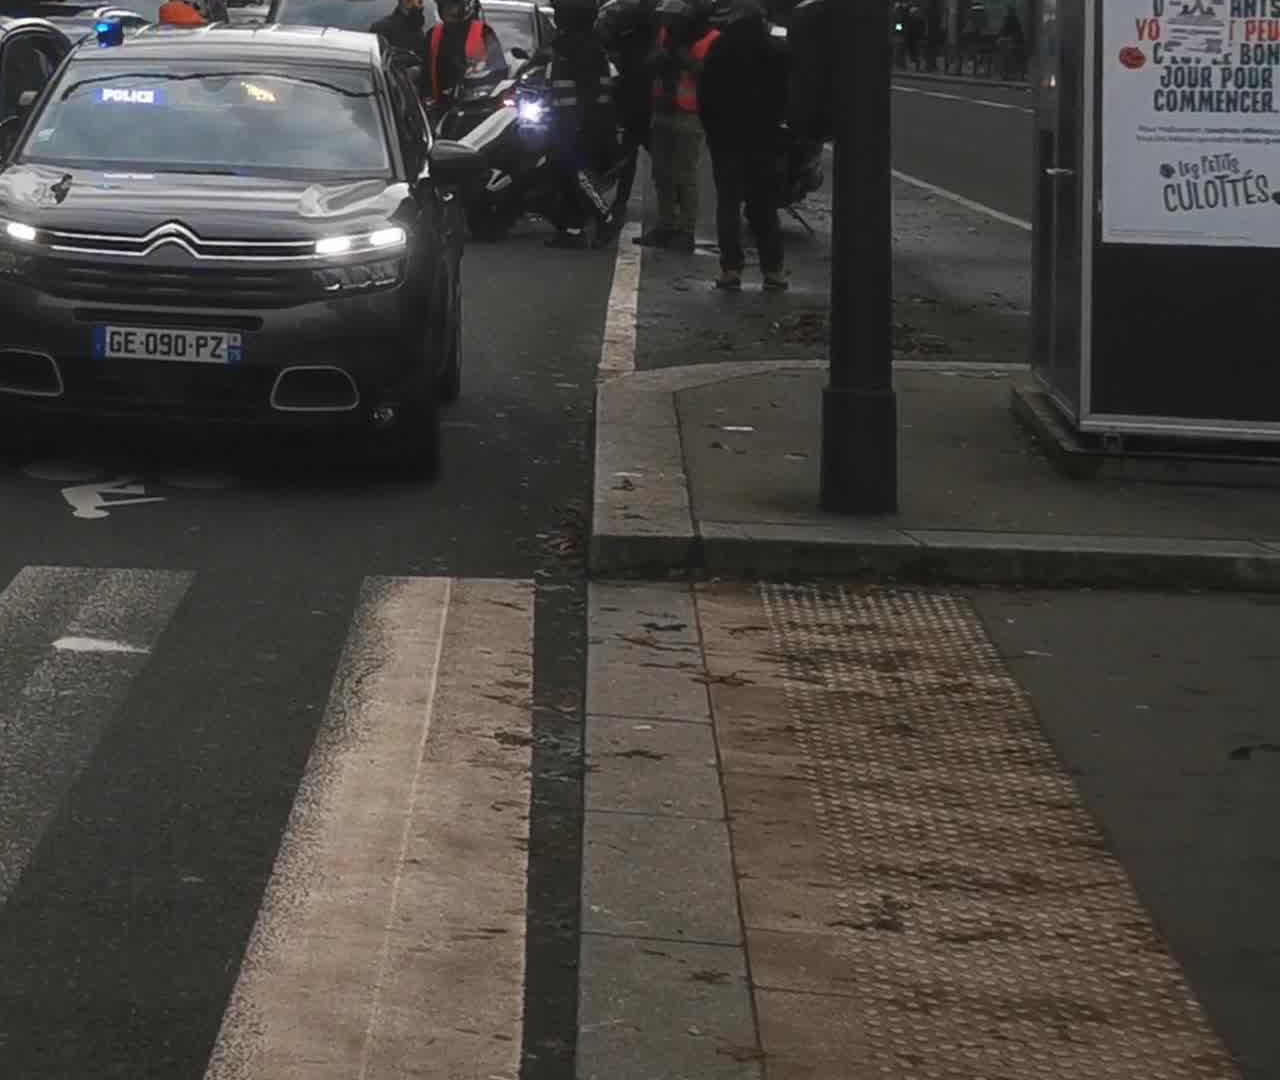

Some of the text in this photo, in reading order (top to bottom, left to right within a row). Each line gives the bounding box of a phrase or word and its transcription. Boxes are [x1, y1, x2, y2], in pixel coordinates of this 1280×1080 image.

[1160, 67, 1273, 89] JOUR POUR
[102, 88, 154, 103] POLICE
[1163, 169, 1269, 212] CULOTTÉS
